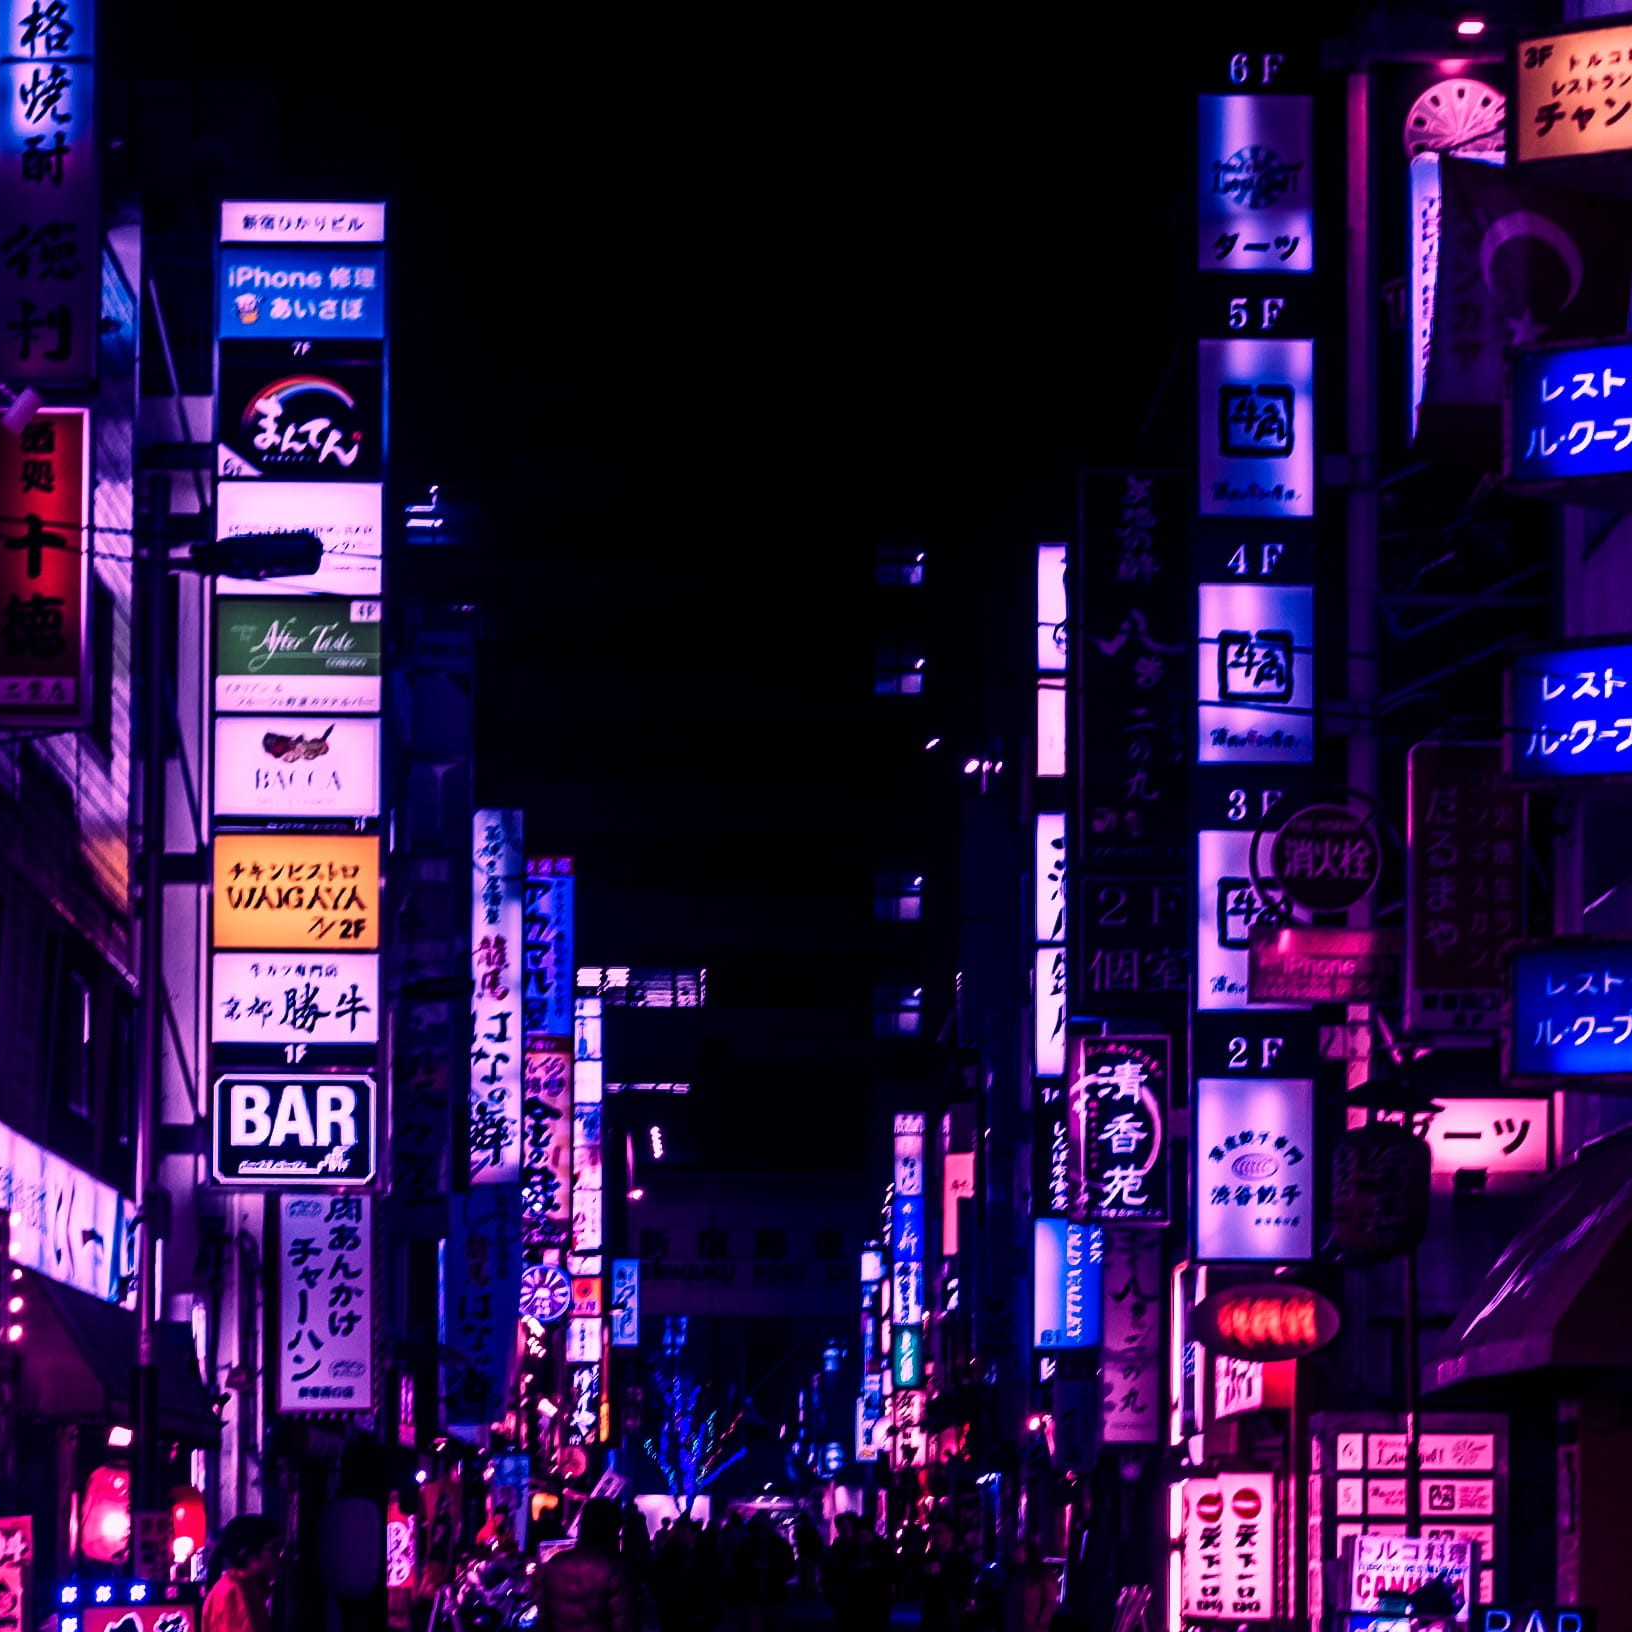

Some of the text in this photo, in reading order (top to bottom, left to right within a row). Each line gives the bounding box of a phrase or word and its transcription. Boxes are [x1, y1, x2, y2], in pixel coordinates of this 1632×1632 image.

[1228, 52, 1285, 85] 6F
[1524, 44, 1553, 69] 3F
[228, 264, 324, 289] iPhone
[1228, 297, 1286, 330] 5F
[253, 393, 361, 468] まんてん
[1228, 543, 1286, 576] 4F
[248, 616, 359, 673] After Taste
[1226, 642, 1289, 688] 牛角
[228, 861, 360, 882] チキンビストロ
[1285, 837, 1369, 881] 消火栓
[226, 885, 367, 911] WAIGAYA
[1096, 884, 1182, 929] 2F
[1087, 943, 1191, 996] 個室
[278, 981, 371, 1035] 勝牛
[1228, 1036, 1286, 1070] 2F
[230, 1083, 358, 1147] BAR
[1099, 1060, 1149, 1207] 清香苑
[324, 1193, 365, 1338] 肉あんかけ
[286, 1237, 326, 1382] チャーハン
[1356, 1539, 1468, 1564] トルコ料理
